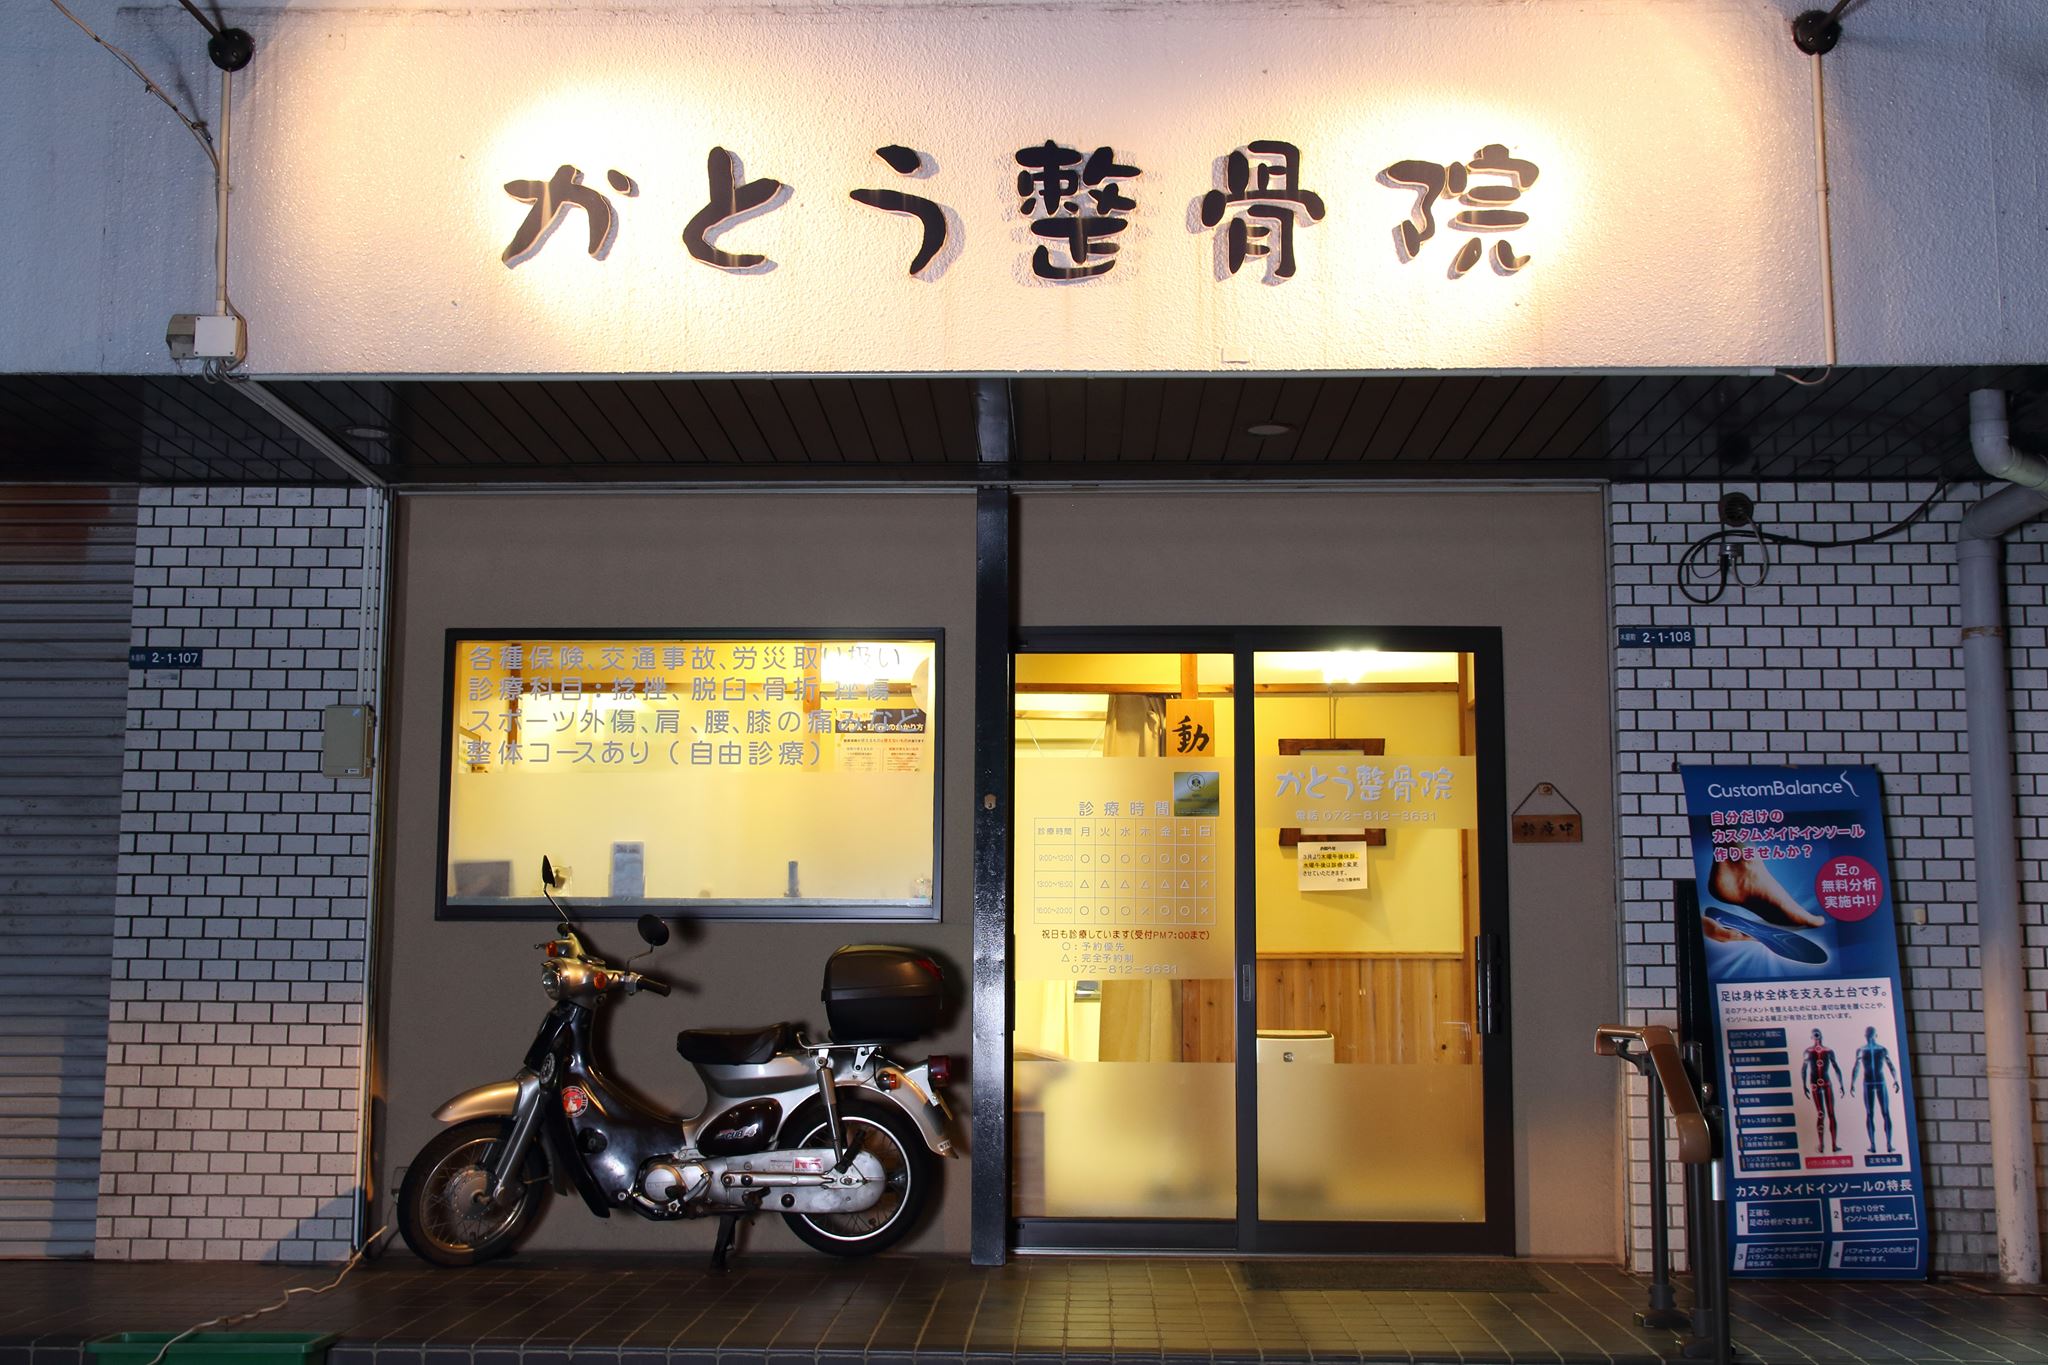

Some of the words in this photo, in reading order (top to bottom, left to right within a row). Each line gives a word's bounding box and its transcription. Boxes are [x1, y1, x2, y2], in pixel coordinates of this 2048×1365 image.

[502, 140, 1538, 279] かとう整骨院
[1643, 632, 1691, 643] 2-1-108
[152, 652, 198, 664] 2-1-107
[468, 706, 920, 734] スポーツ外傷、肩、腰、膝の痛みなど
[1172, 715, 1209, 753] 動
[466, 740, 821, 767] 整体コースあり（自由診療）
[1276, 765, 1454, 803] かとう整骨院
[1708, 780, 1842, 798] CustomBalance
[1079, 801, 1170, 817] 診療時間
[1711, 810, 1784, 826] 自分だけの
[1081, 827, 1090, 837] 月
[1100, 827, 1110, 837] 火
[1120, 827, 1130, 837] 水
[1161, 827, 1170, 837] 金
[1181, 827, 1191, 837] 土
[1712, 824, 1865, 844] カスタムメイドインソール
[1714, 845, 1812, 862] 作りませんか？
[1835, 864, 1859, 876] 足の
[1821, 878, 1877, 893] 無料分析
[1825, 894, 1877, 908] 実施中!!
[1721, 986, 1887, 1002] 足は身体全体を支える土台です。
[1736, 1179, 1913, 1198] カスタムメイドインソールの特長
